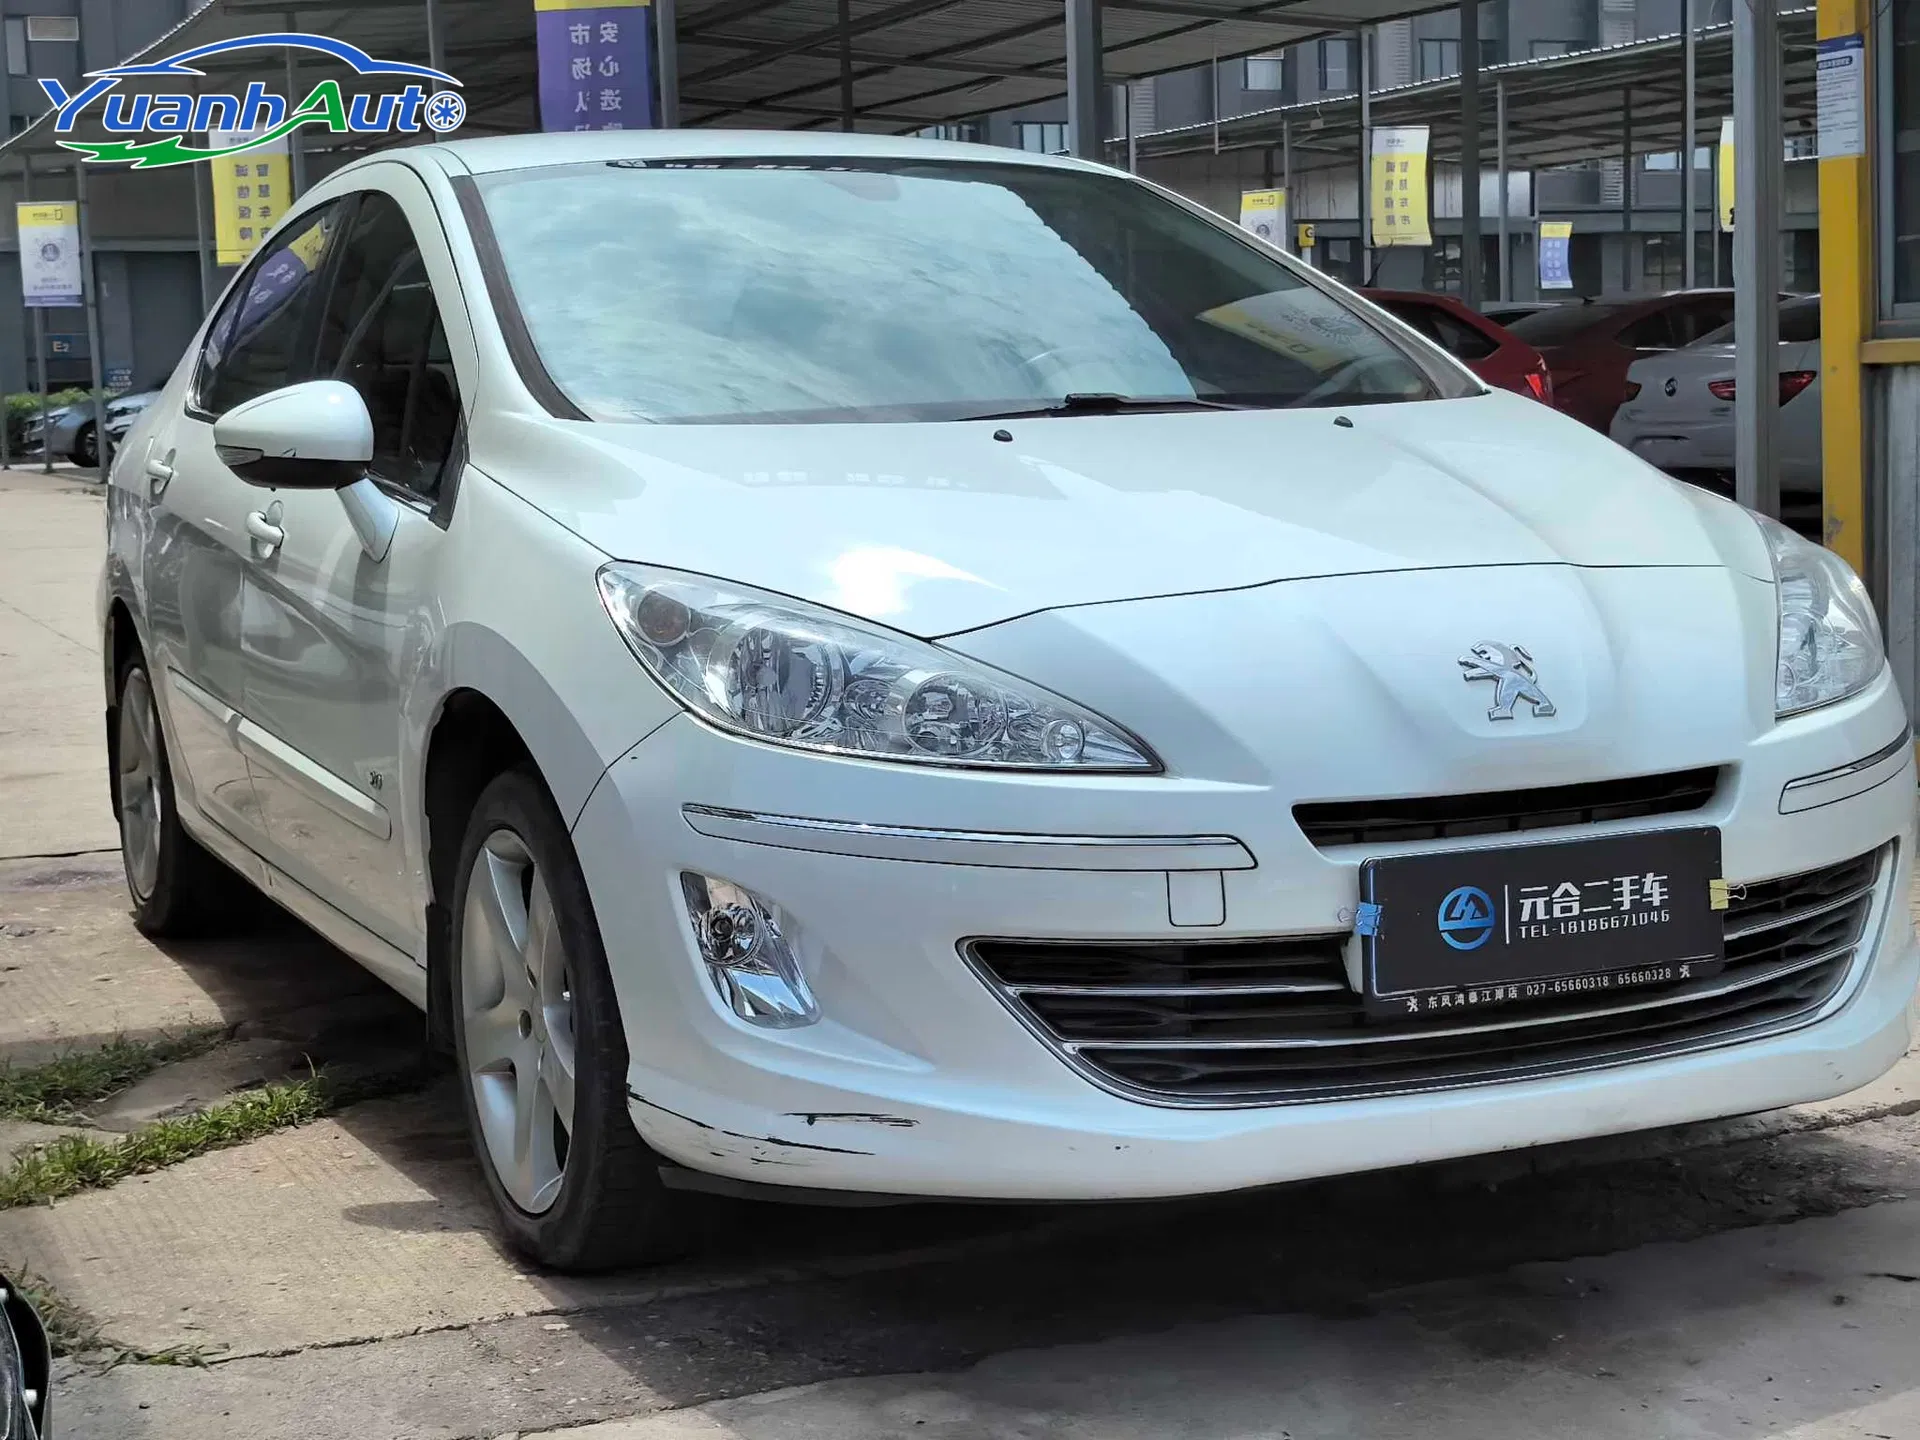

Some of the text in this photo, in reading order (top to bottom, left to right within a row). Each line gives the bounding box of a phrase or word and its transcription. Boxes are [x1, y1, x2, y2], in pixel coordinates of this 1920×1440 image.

[1519, 872, 1669, 922] 元合二手车
